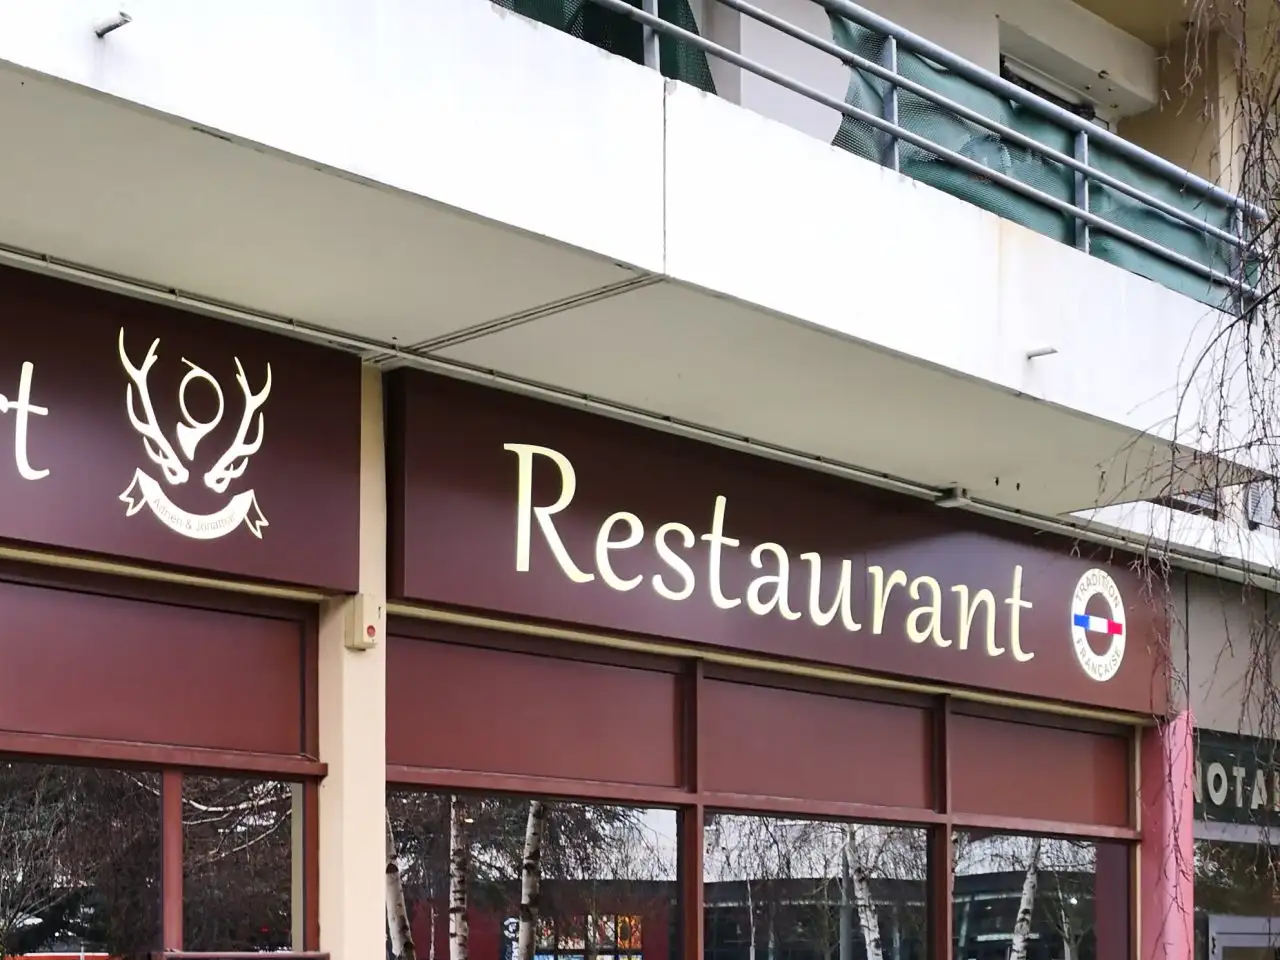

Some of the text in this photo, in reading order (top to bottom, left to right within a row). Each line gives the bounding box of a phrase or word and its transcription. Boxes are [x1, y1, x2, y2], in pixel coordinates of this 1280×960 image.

[503, 443, 1036, 663] Restaurant
[1075, 571, 1121, 609] TRADITION
[1075, 637, 1122, 678] FRANÇAISE
